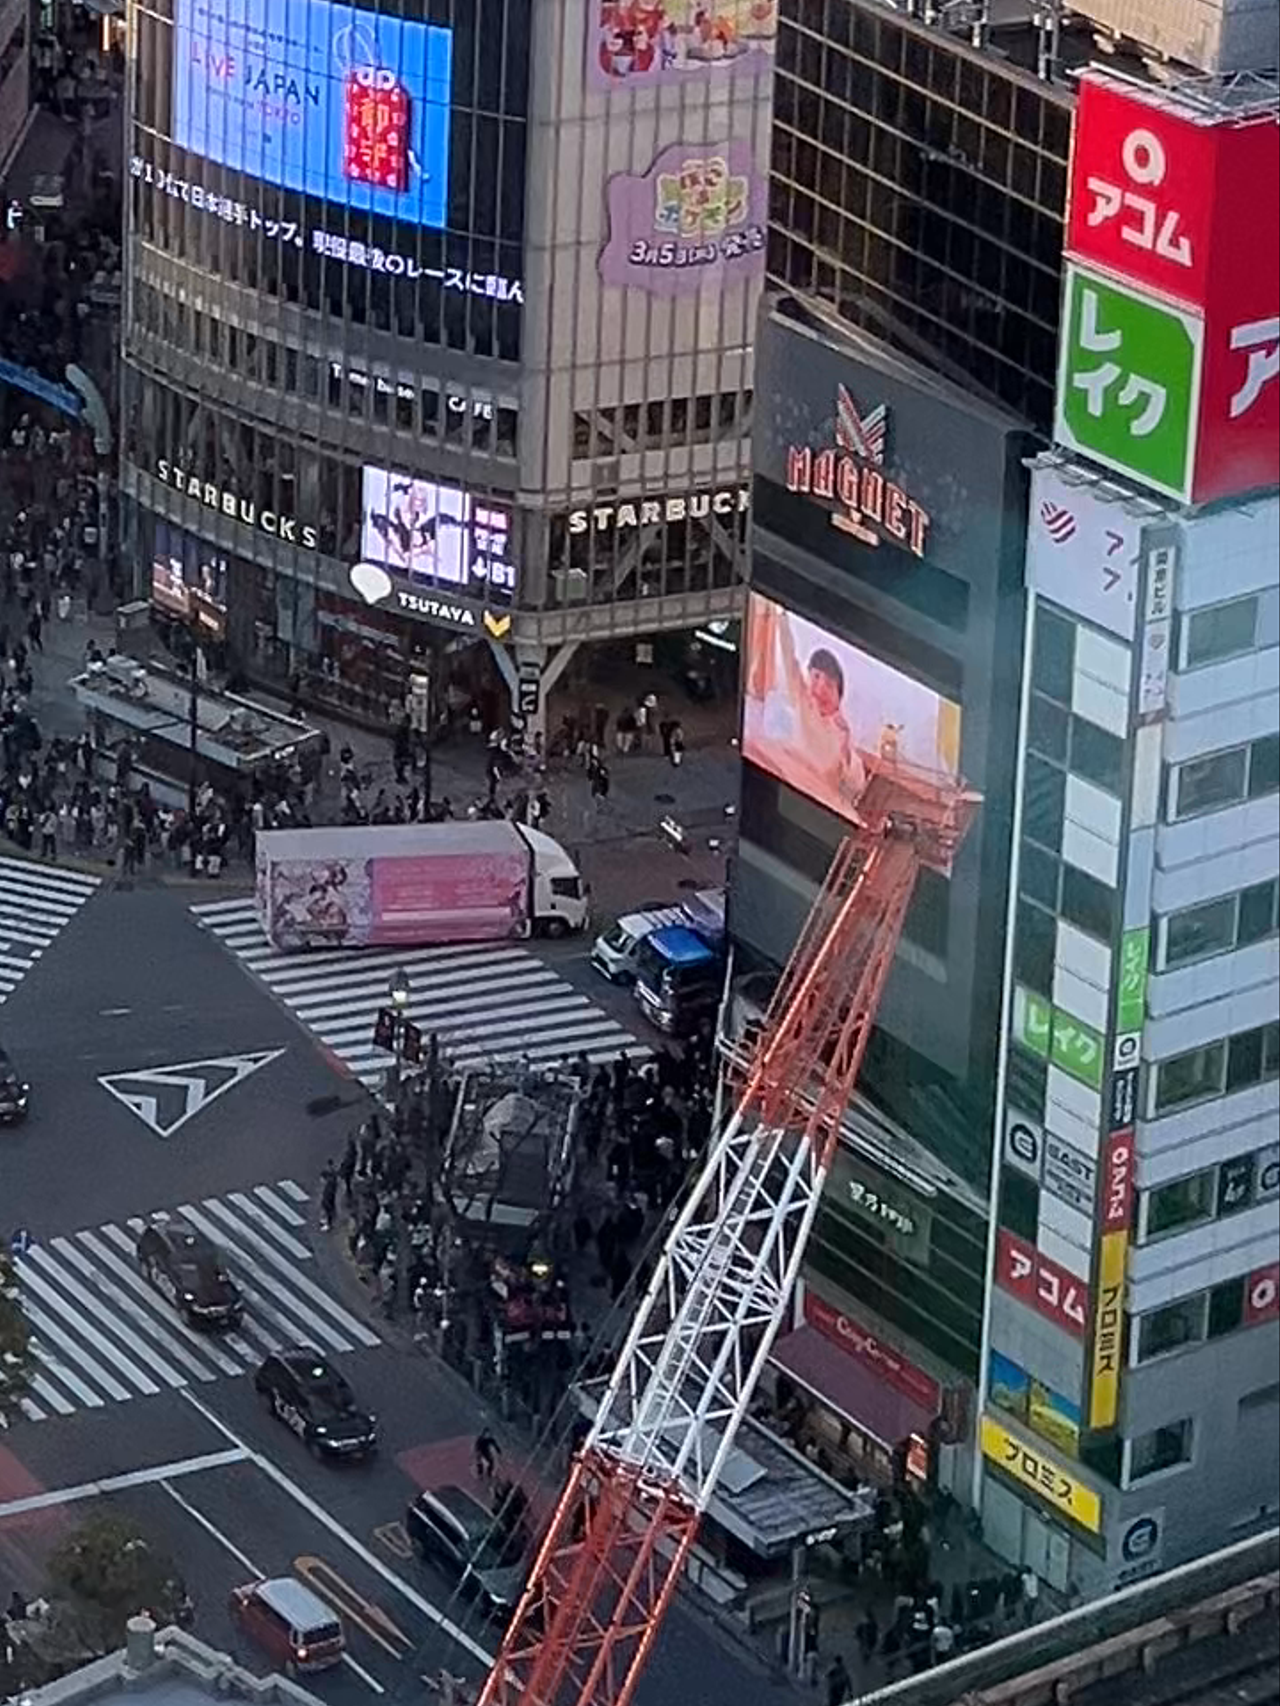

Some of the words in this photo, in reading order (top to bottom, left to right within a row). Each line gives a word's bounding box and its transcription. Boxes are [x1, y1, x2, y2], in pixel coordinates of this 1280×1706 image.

[243, 67, 321, 108] JAPAN
[1085, 175, 1195, 270] アコム
[1072, 287, 1168, 439] レイク
[157, 458, 318, 549] STARBUCKS
[568, 490, 752, 535] STARBUCK
[786, 443, 931, 560] MAGNET
[396, 591, 476, 627] TSUTAYA
[1027, 1002, 1098, 1066] レイク
[1008, 1247, 1086, 1326] アコム
[1096, 1284, 1121, 1375] プロミス
[1003, 1437, 1074, 1507] プロミス
